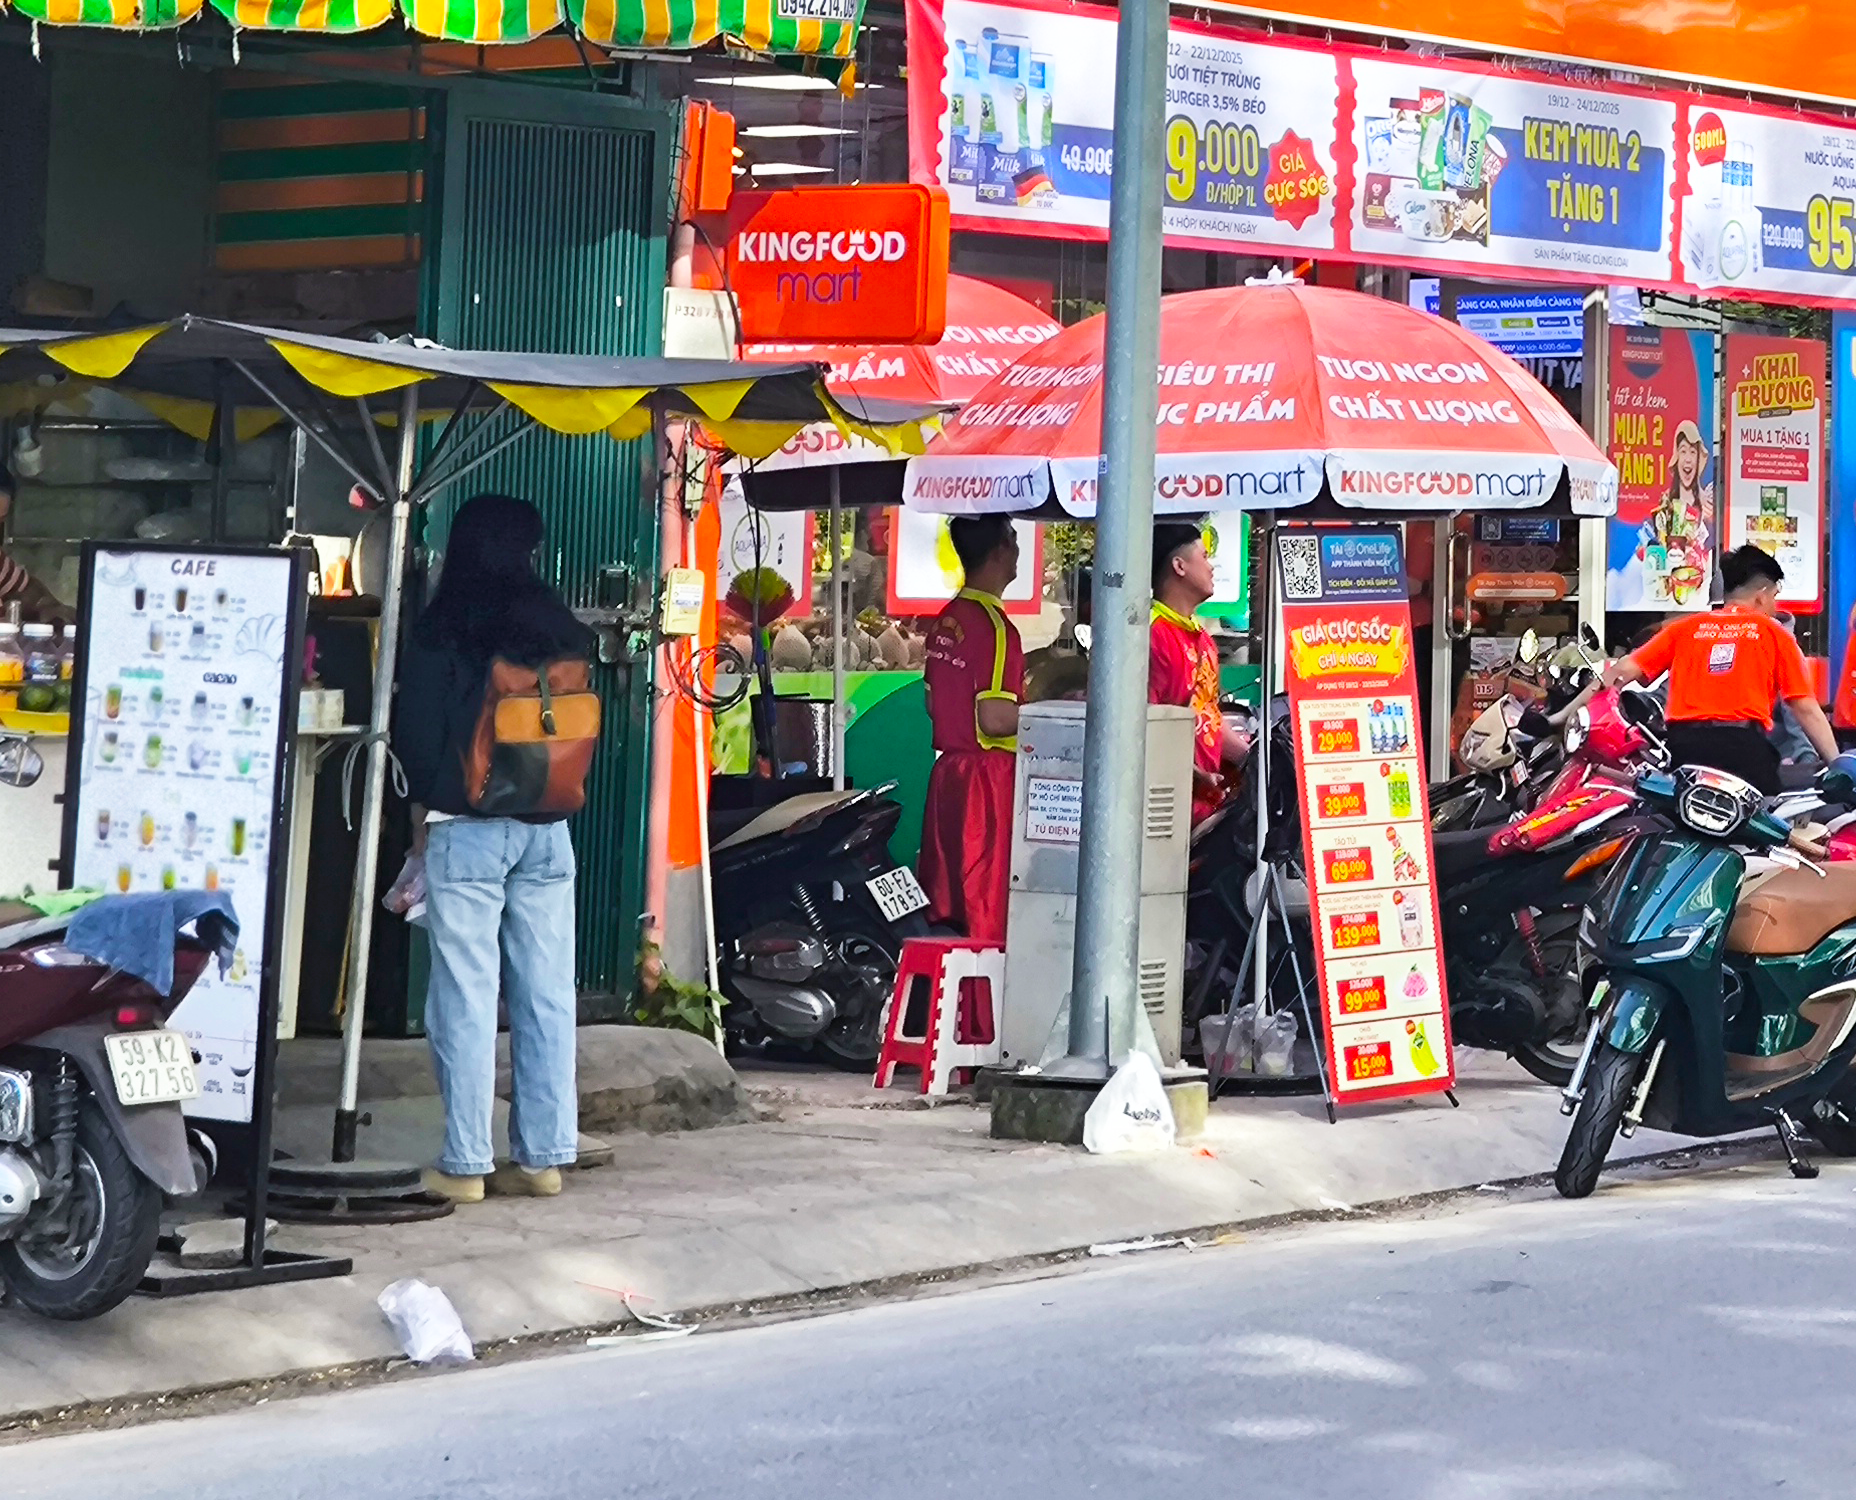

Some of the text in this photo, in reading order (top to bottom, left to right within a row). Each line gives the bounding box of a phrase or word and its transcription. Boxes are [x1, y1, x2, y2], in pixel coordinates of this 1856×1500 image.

[1190, 45, 1243, 64] 22/12/2025
[1192, 66, 1218, 88] TIỆT
[1221, 69, 1261, 91] TRÙNG
[1165, 88, 1267, 116] BURGER 3,5% BÉO
[1547, 94, 1620, 115] 19/12 24/12/2025
[1523, 117, 1641, 172] KEM MUA 2
[1694, 127, 1726, 151] 500ML
[991, 155, 1021, 174] Milk
[1165, 115, 1260, 202] 9.000
[1280, 151, 1307, 174] GIÁ
[1804, 150, 1829, 167] NƯỚC
[1831, 153, 1854, 170] UỐNG
[1264, 171, 1330, 206] CỰC SỐC
[1546, 171, 1619, 233] TẶNG 1
[1168, 215, 1175, 228] 4
[1233, 219, 1258, 235] NGÀY
[738, 229, 907, 262] KINGFOOD
[776, 264, 861, 304] mart
[984, 324, 1061, 345] NGON
[935, 351, 999, 377] CHẤT
[1000, 364, 1048, 387] TƯƠI
[1317, 355, 1490, 384] TƯƠI NGON
[1755, 356, 1797, 381] KHAI
[1223, 362, 1276, 392] THỊ
[1613, 386, 1669, 409] tất cả kem
[1738, 379, 1813, 408] TRƯƠNG
[958, 396, 1080, 431] CHẤT LƯỢNG
[1193, 390, 1297, 424] PHẨM
[1328, 390, 1521, 428] CHẤT LƯỢNG
[1613, 412, 1664, 446] MUA 2
[1740, 426, 1811, 450] MUA 1 TẶNG 1
[1613, 445, 1665, 489] TẶNG 1
[1356, 542, 1392, 555] OneLife
[170, 558, 218, 577] CAFE
[1302, 615, 1392, 645] GIÁ CỰC SỐC
[1693, 630, 1717, 639] GIAO
[1718, 630, 1745, 639] NGAY
[1698, 622, 1758, 632] MUA ONLINE
[1318, 648, 1378, 670] CHỈ 4 NGÀY
[1476, 684, 1494, 695] 115
[1318, 731, 1353, 752] 29.000
[1324, 796, 1360, 816] 39.000
[1034, 823, 1070, 837] TỦ ĐIỆN
[1331, 860, 1367, 881] 69.000
[1335, 924, 1377, 947] 139.000
[1345, 990, 1380, 1012] 99.000
[1353, 1055, 1387, 1078] 15.000
[121, 1066, 194, 1099] 327.56
